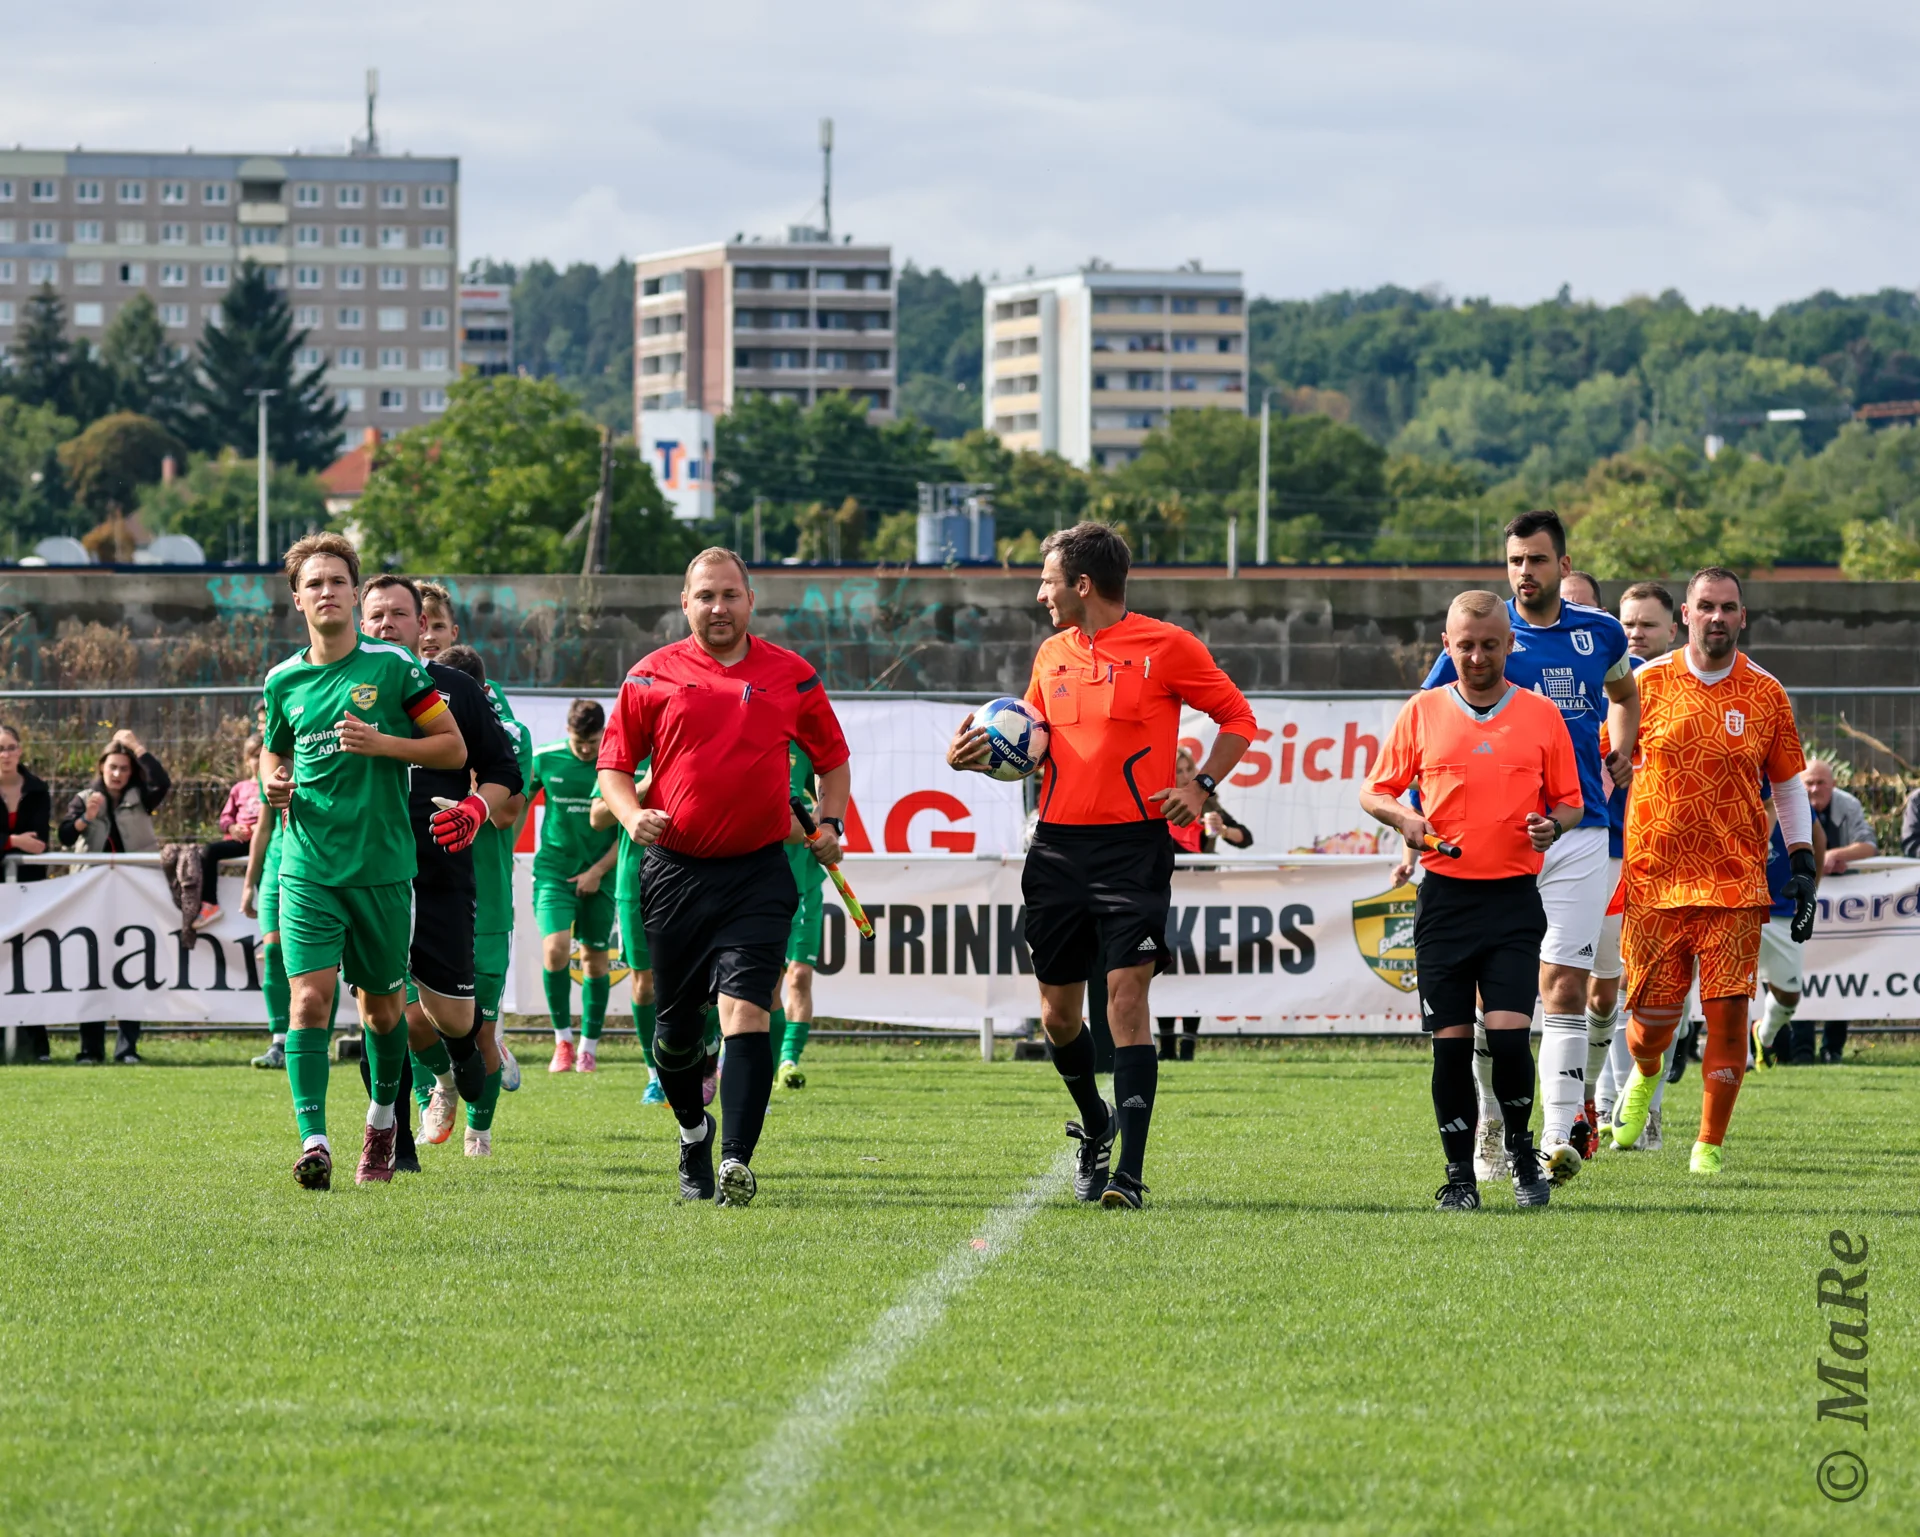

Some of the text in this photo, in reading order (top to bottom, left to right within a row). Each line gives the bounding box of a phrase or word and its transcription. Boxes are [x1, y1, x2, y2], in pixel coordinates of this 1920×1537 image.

[1541, 667, 1574, 677] UNSER
[991, 736, 1029, 768] uhlsport
[1796, 902, 1813, 931] TITAN
[375, 1079, 400, 1088] JAKO
[296, 1104, 319, 1116] JAKO
